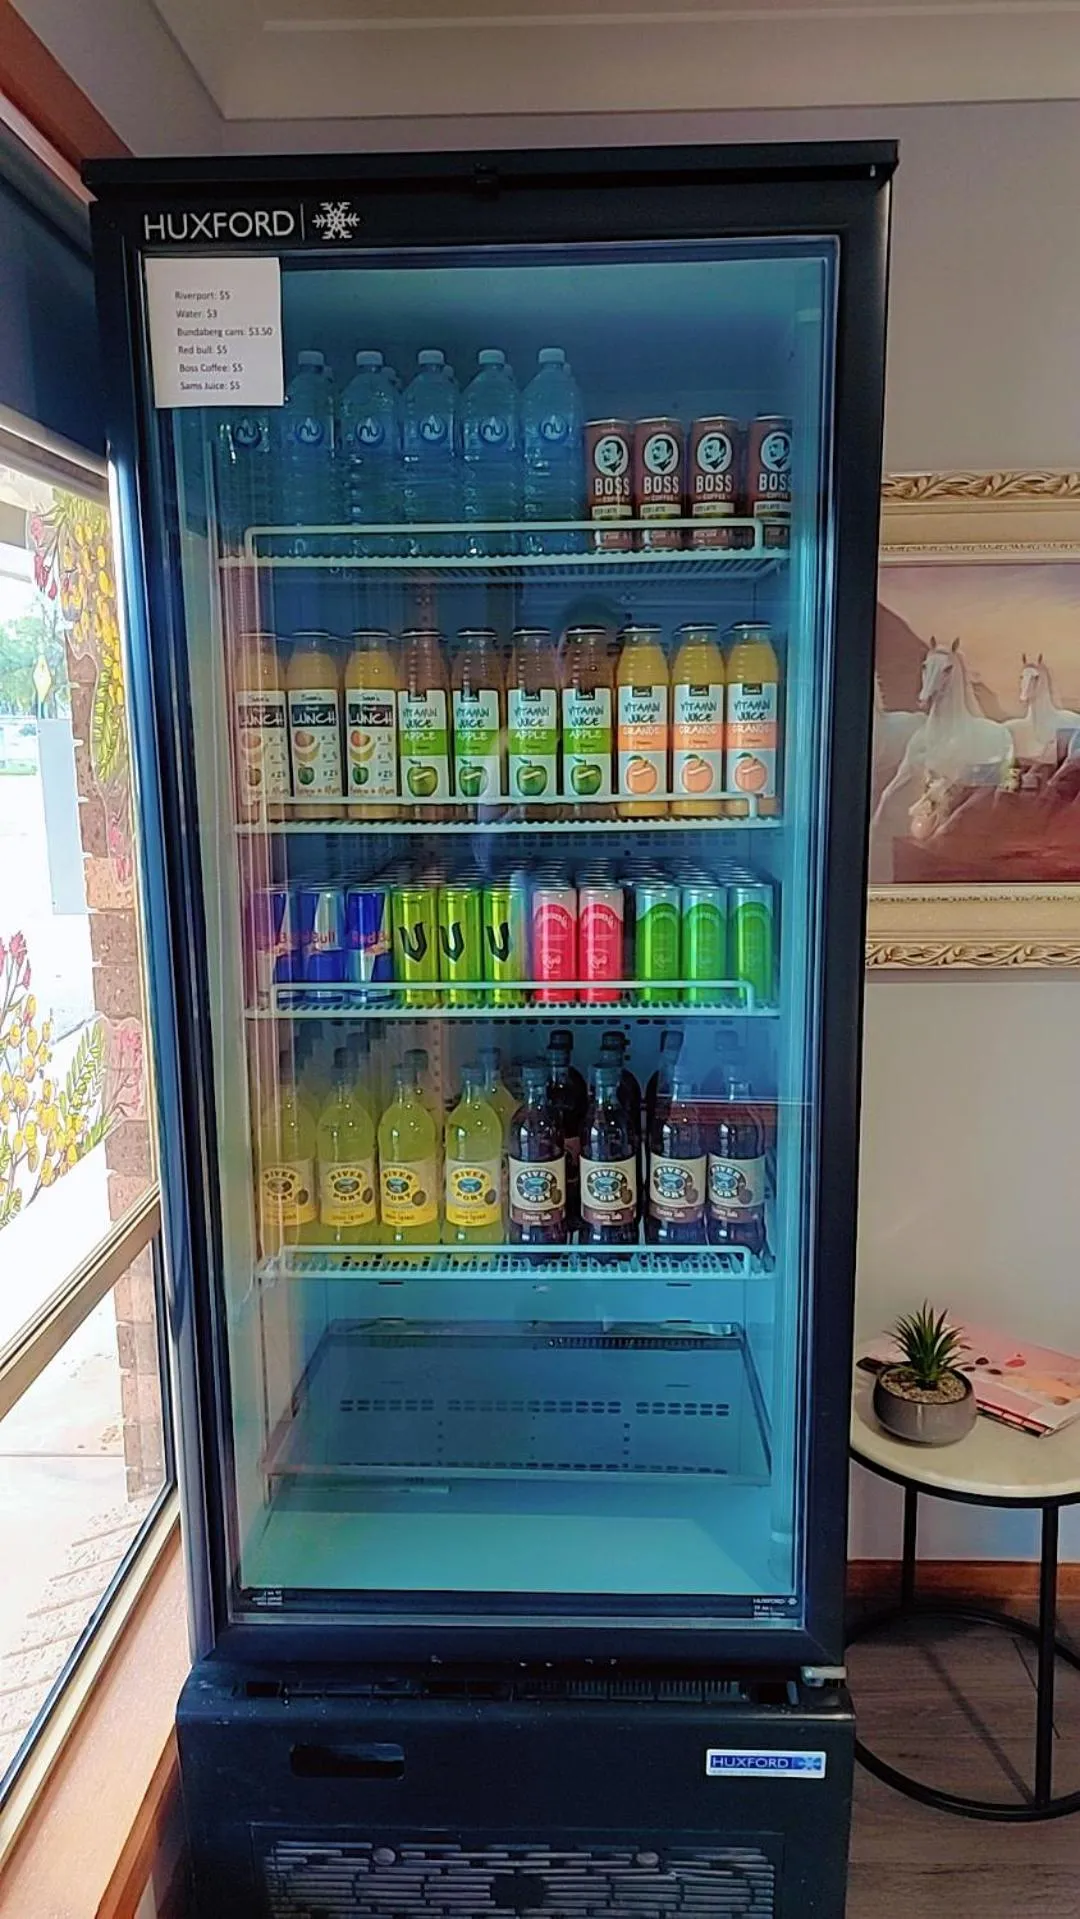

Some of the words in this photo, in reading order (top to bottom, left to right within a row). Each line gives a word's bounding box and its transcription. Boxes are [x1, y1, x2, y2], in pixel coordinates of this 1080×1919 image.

[144, 209, 295, 241] HUXFORD
[175, 291, 217, 301] Riverport:
[220, 290, 230, 300] $5
[207, 309, 217, 318] $3
[177, 328, 222, 338] Bundaberg
[249, 327, 273, 336] $3.50
[178, 346, 194, 354] Red
[217, 345, 227, 355] $5
[179, 364, 198, 372] Boss
[200, 363, 229, 372] Coffee:
[233, 364, 243, 373] $5
[204, 381, 228, 390] Juice:
[230, 381, 241, 390] $5
[594, 477, 630, 496] BOSS
[643, 475, 679, 494] BOSS
[695, 474, 732, 493] BOSS
[293, 712, 335, 725] LUNCH
[350, 711, 392, 725] LUNCH
[571, 717, 600, 726] JUICE
[628, 713, 656, 723] JUICE
[684, 712, 712, 723] JUICE
[737, 711, 766, 722] JUICE
[406, 719, 433, 728] JUICE
[458, 719, 485, 728] JUICE
[517, 718, 544, 727] JUICE
[515, 730, 547, 740] APPLE
[569, 729, 602, 739] APPLE
[330, 1170, 363, 1181] RIVER
[383, 1171, 413, 1181] RIVER
[454, 1171, 486, 1180] RIVER
[520, 1170, 553, 1181] RIVER
[591, 1170, 624, 1181] RIVER
[656, 1167, 689, 1179] RIVER
[711, 1166, 741, 1179] RIVER
[456, 1191, 483, 1201] PORT
[523, 1191, 551, 1201] PORT
[593, 1191, 621, 1201] PORT
[658, 1187, 685, 1198] PORT
[712, 1756, 789, 1768] HUXFORD
